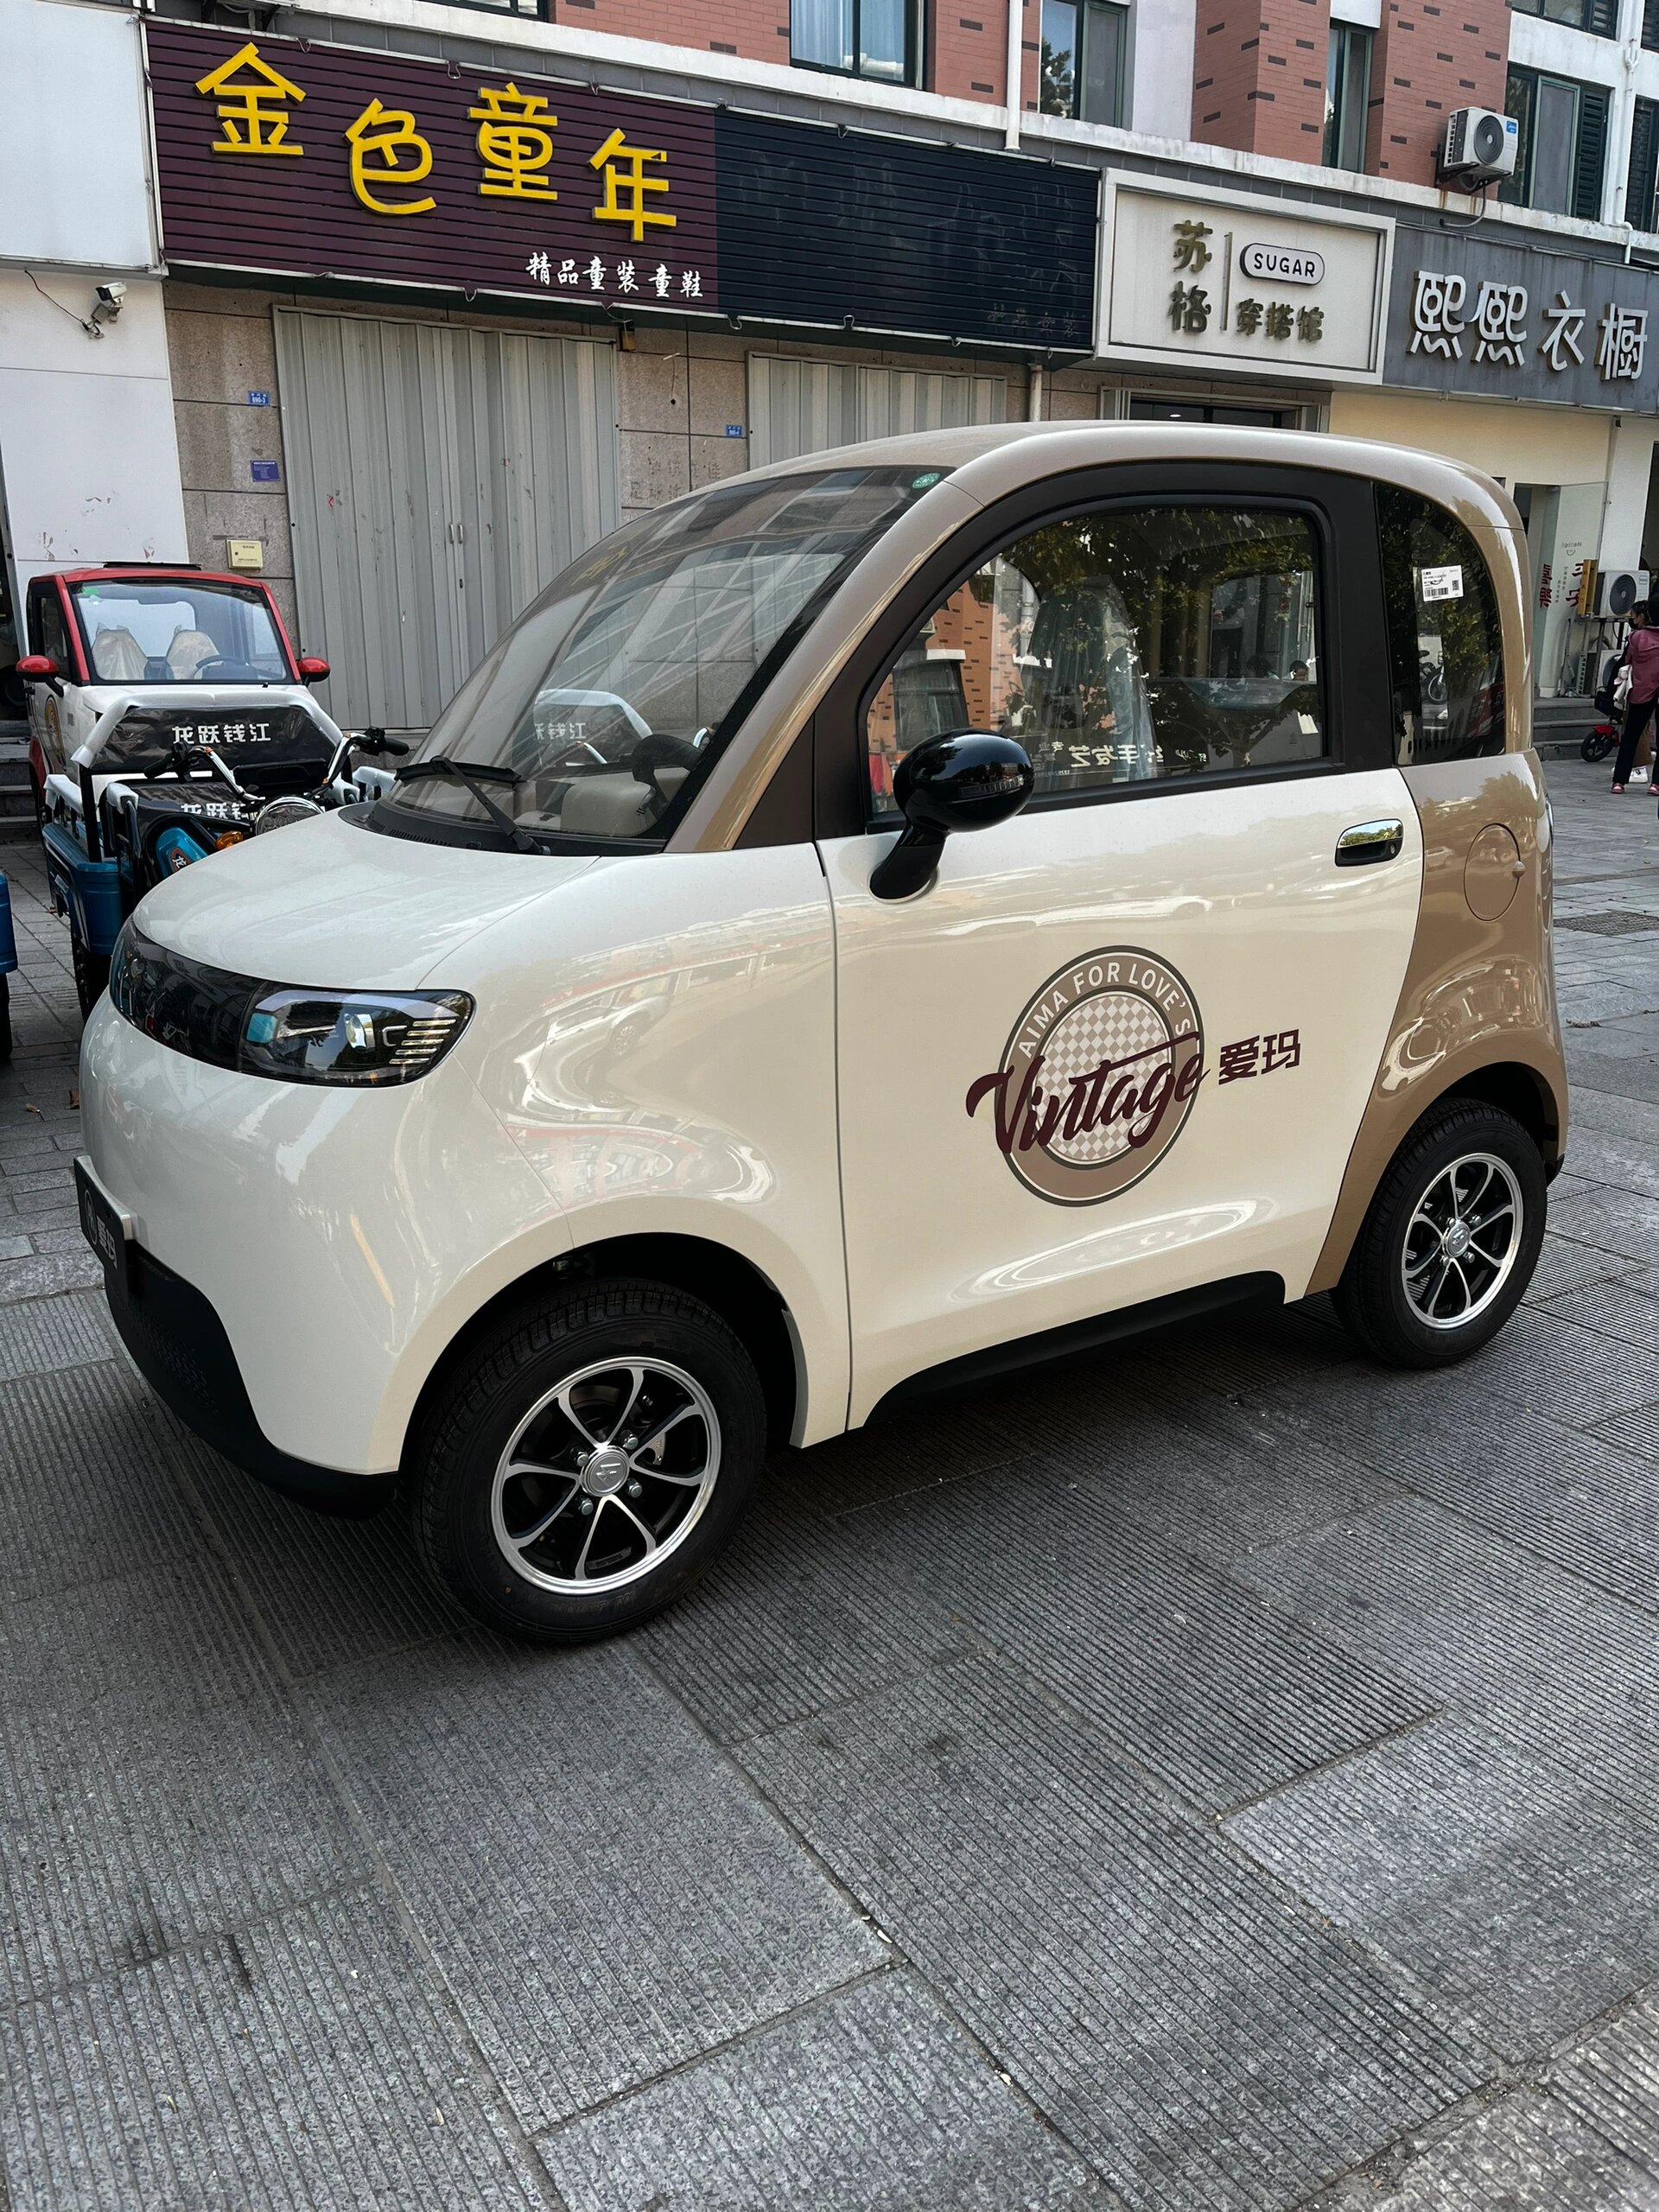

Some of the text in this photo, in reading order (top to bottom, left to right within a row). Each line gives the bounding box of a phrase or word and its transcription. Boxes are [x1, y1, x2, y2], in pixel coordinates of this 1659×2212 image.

[195, 41, 677, 242] 金色童年
[525, 251, 703, 299] 精品童装童鞋
[1168, 219, 1213, 334] 苏格
[1254, 252, 1315, 278] SUGAR
[1236, 298, 1324, 342] 穿搭馆
[1406, 270, 1649, 381] 熙熙衣橱
[172, 723, 271, 744] 龙跃钱江
[1019, 989, 1069, 1058] AIMA
[1073, 962, 1120, 995] FOR
[966, 1032, 1211, 1154] Vintage
[1218, 1028, 1301, 1086] 爱玛
